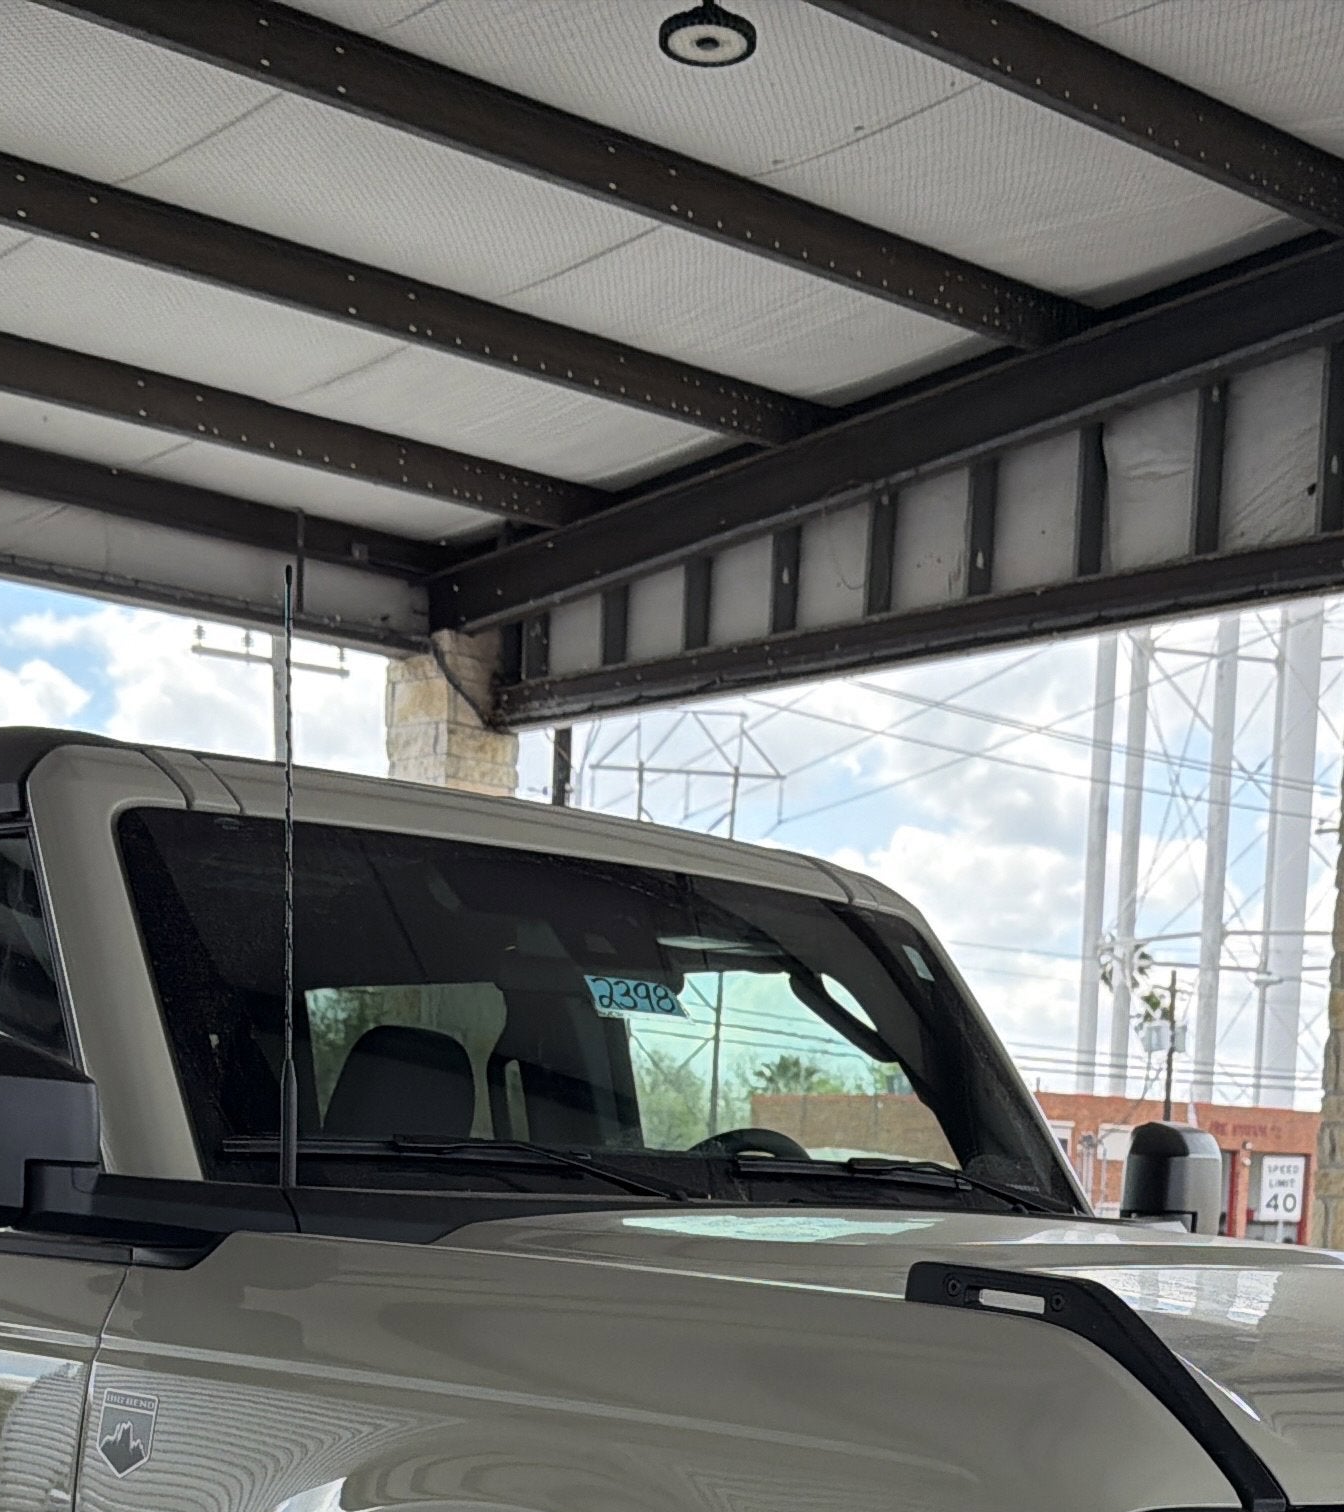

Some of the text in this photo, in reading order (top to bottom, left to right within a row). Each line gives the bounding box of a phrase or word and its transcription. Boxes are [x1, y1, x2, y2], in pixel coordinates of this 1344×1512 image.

[591, 977, 676, 1013] 2398
[1267, 1164, 1300, 1175] SPEED
[1269, 1178, 1296, 1189] LIMIT
[1265, 1192, 1297, 1213] 40
